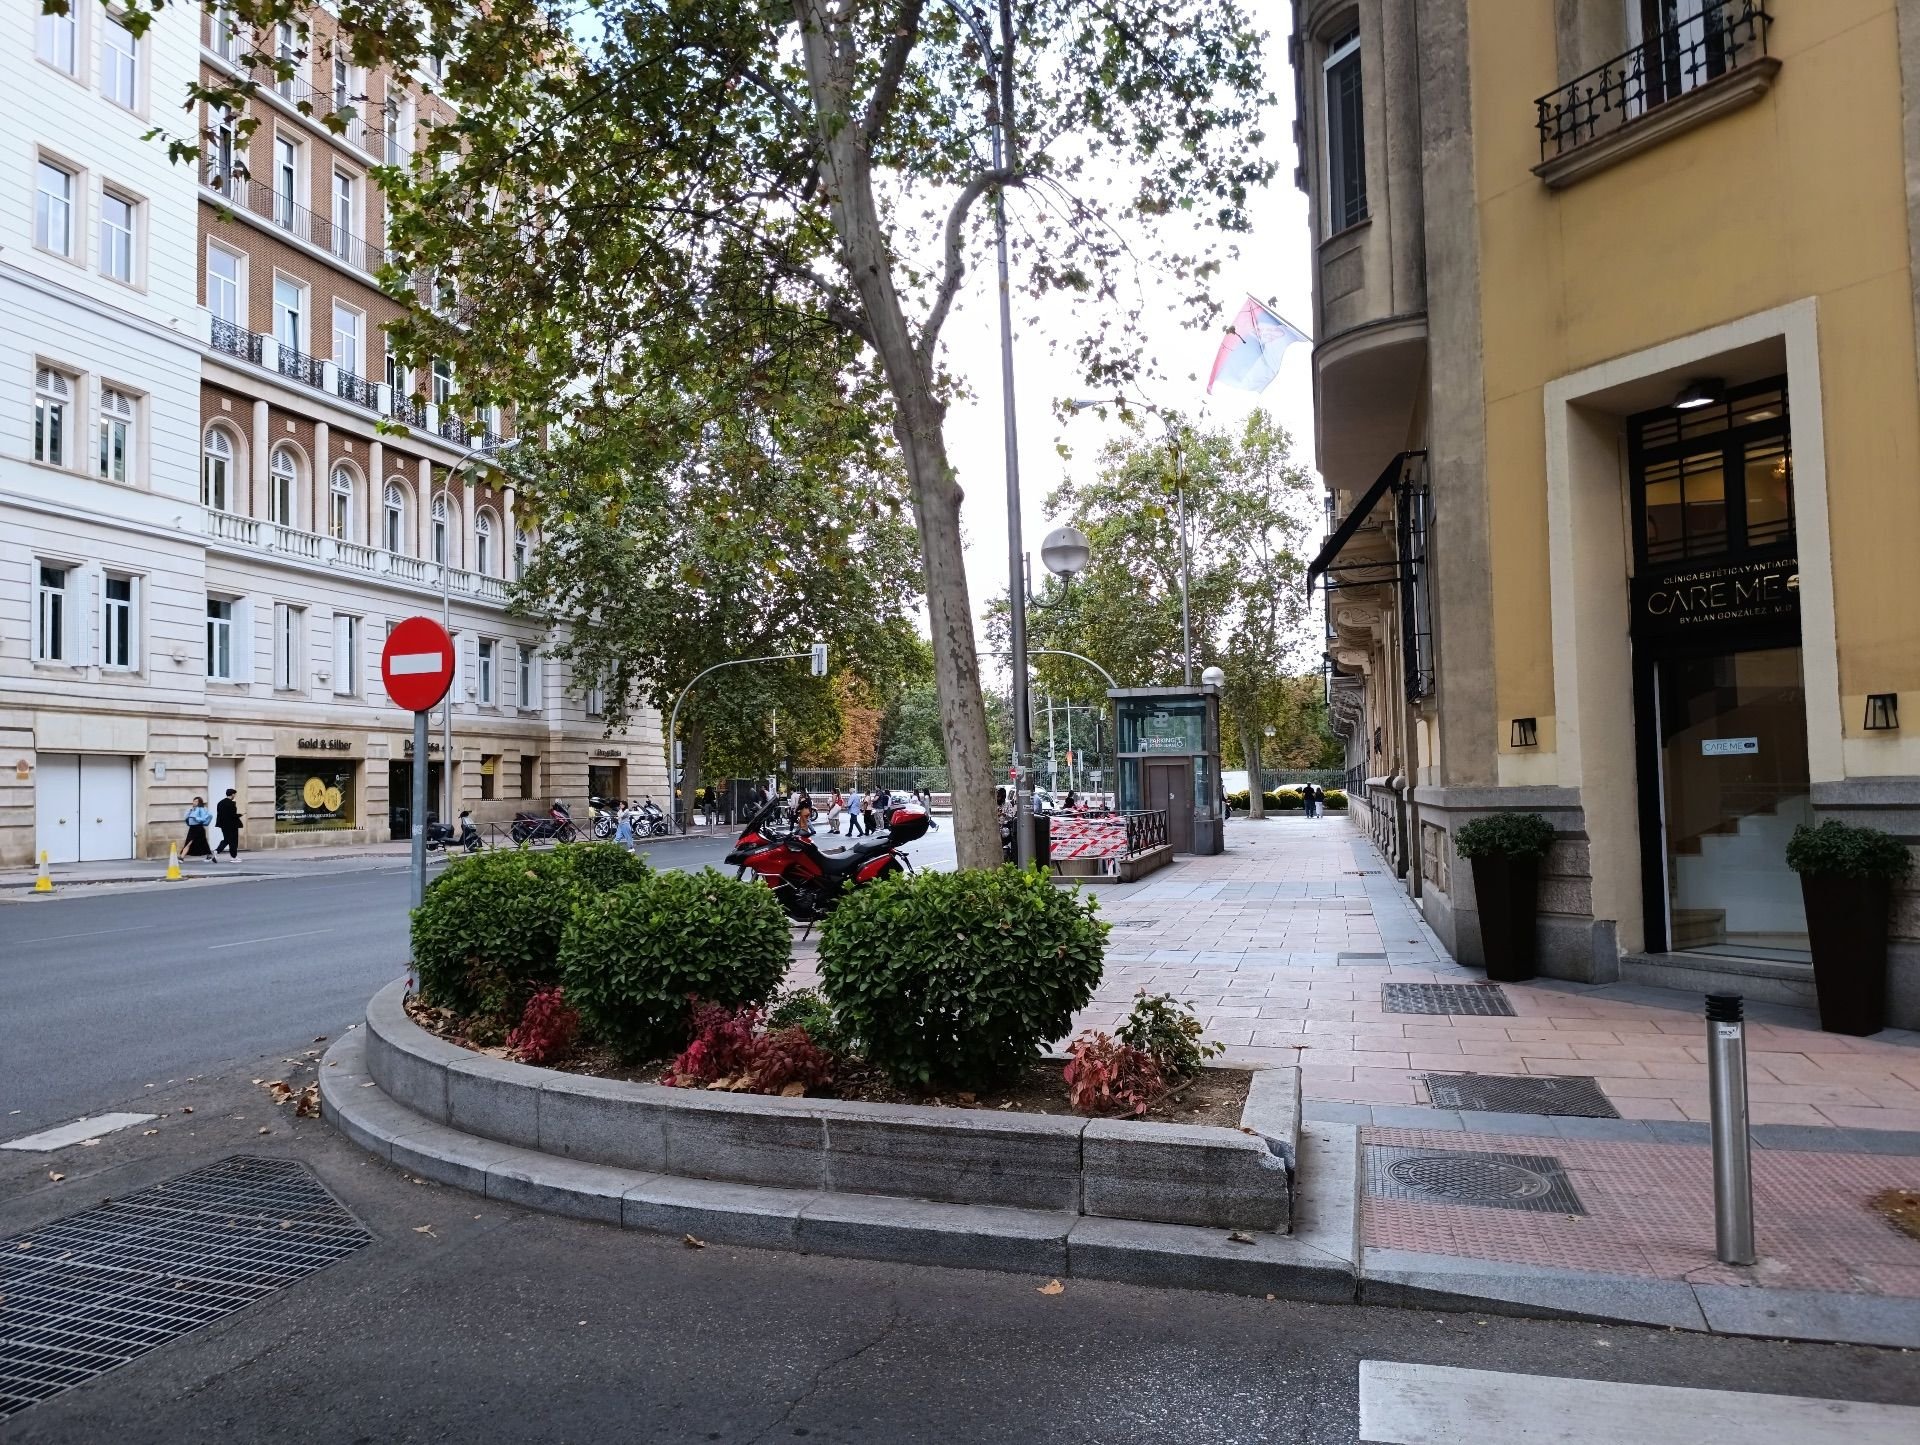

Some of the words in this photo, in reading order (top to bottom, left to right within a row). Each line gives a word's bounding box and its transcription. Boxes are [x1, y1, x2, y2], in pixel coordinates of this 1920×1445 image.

[1663, 573, 1698, 585] CLÍNICA
[1699, 566, 1744, 579] ESTÉTICA
[1745, 565, 1751, 573] Y
[1647, 582, 1727, 615] CARE
[1735, 574, 1782, 604] ME
[1679, 616, 1691, 624] BY
[1692, 613, 1715, 623] ALAN
[1717, 606, 1767, 620] GONZÁLEZ
[298, 738, 319, 750] Gold
[320, 739, 327, 749] &
[1704, 743, 1728, 751] CARE
[1729, 742, 1743, 750] ME
